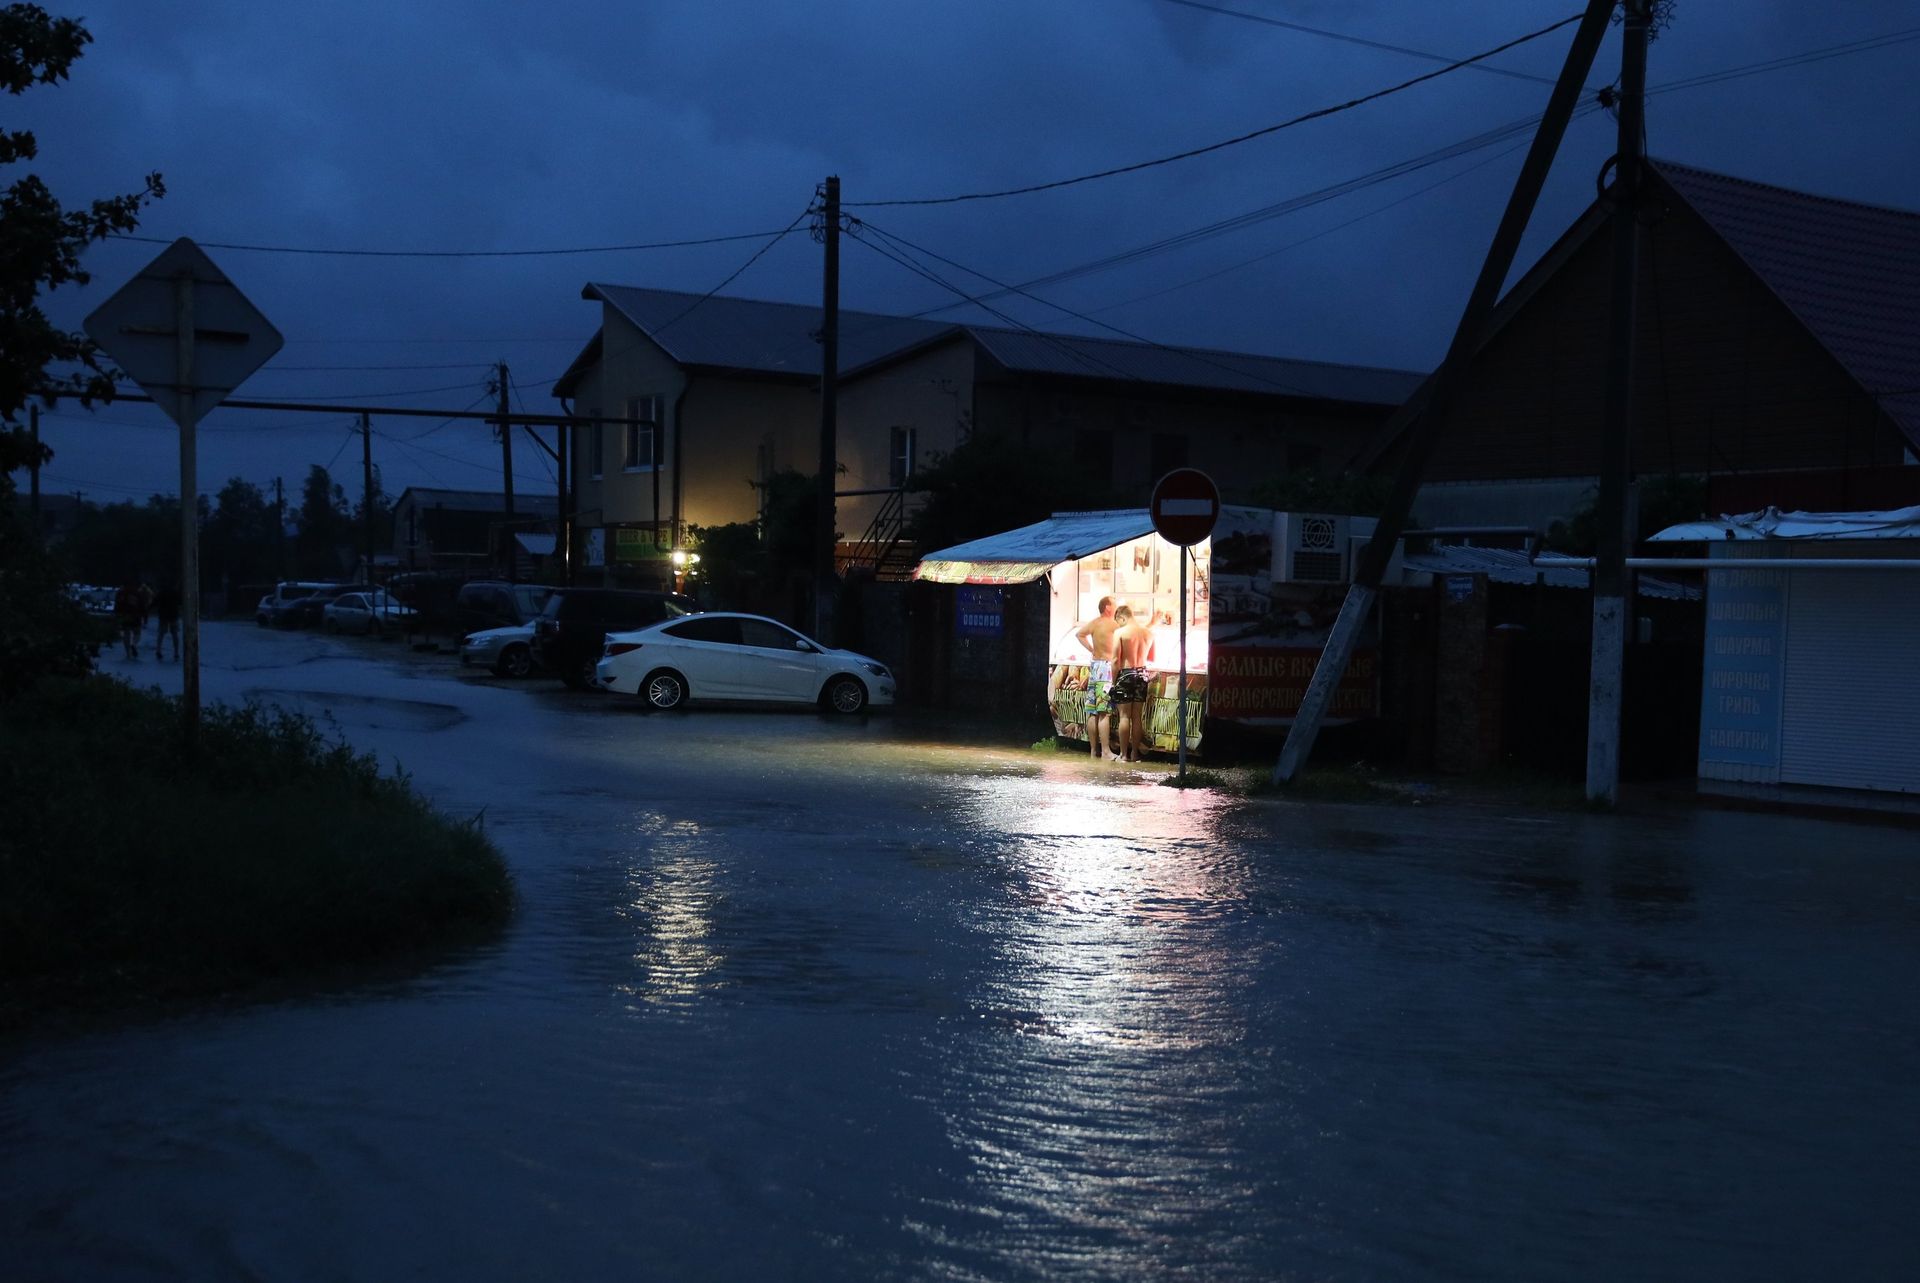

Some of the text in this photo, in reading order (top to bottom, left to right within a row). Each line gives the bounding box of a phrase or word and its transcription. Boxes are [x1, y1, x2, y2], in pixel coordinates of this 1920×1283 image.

[1711, 602, 1777, 621] ШАШЛЫК
[1714, 636, 1771, 655] ШАУРМА
[1216, 655, 1287, 678] САМЫЕ
[1711, 671, 1770, 690] КУРОЧКА
[1719, 695, 1760, 715] ГРИЛЬ
[1709, 728, 1769, 750] НАПИТКИ
